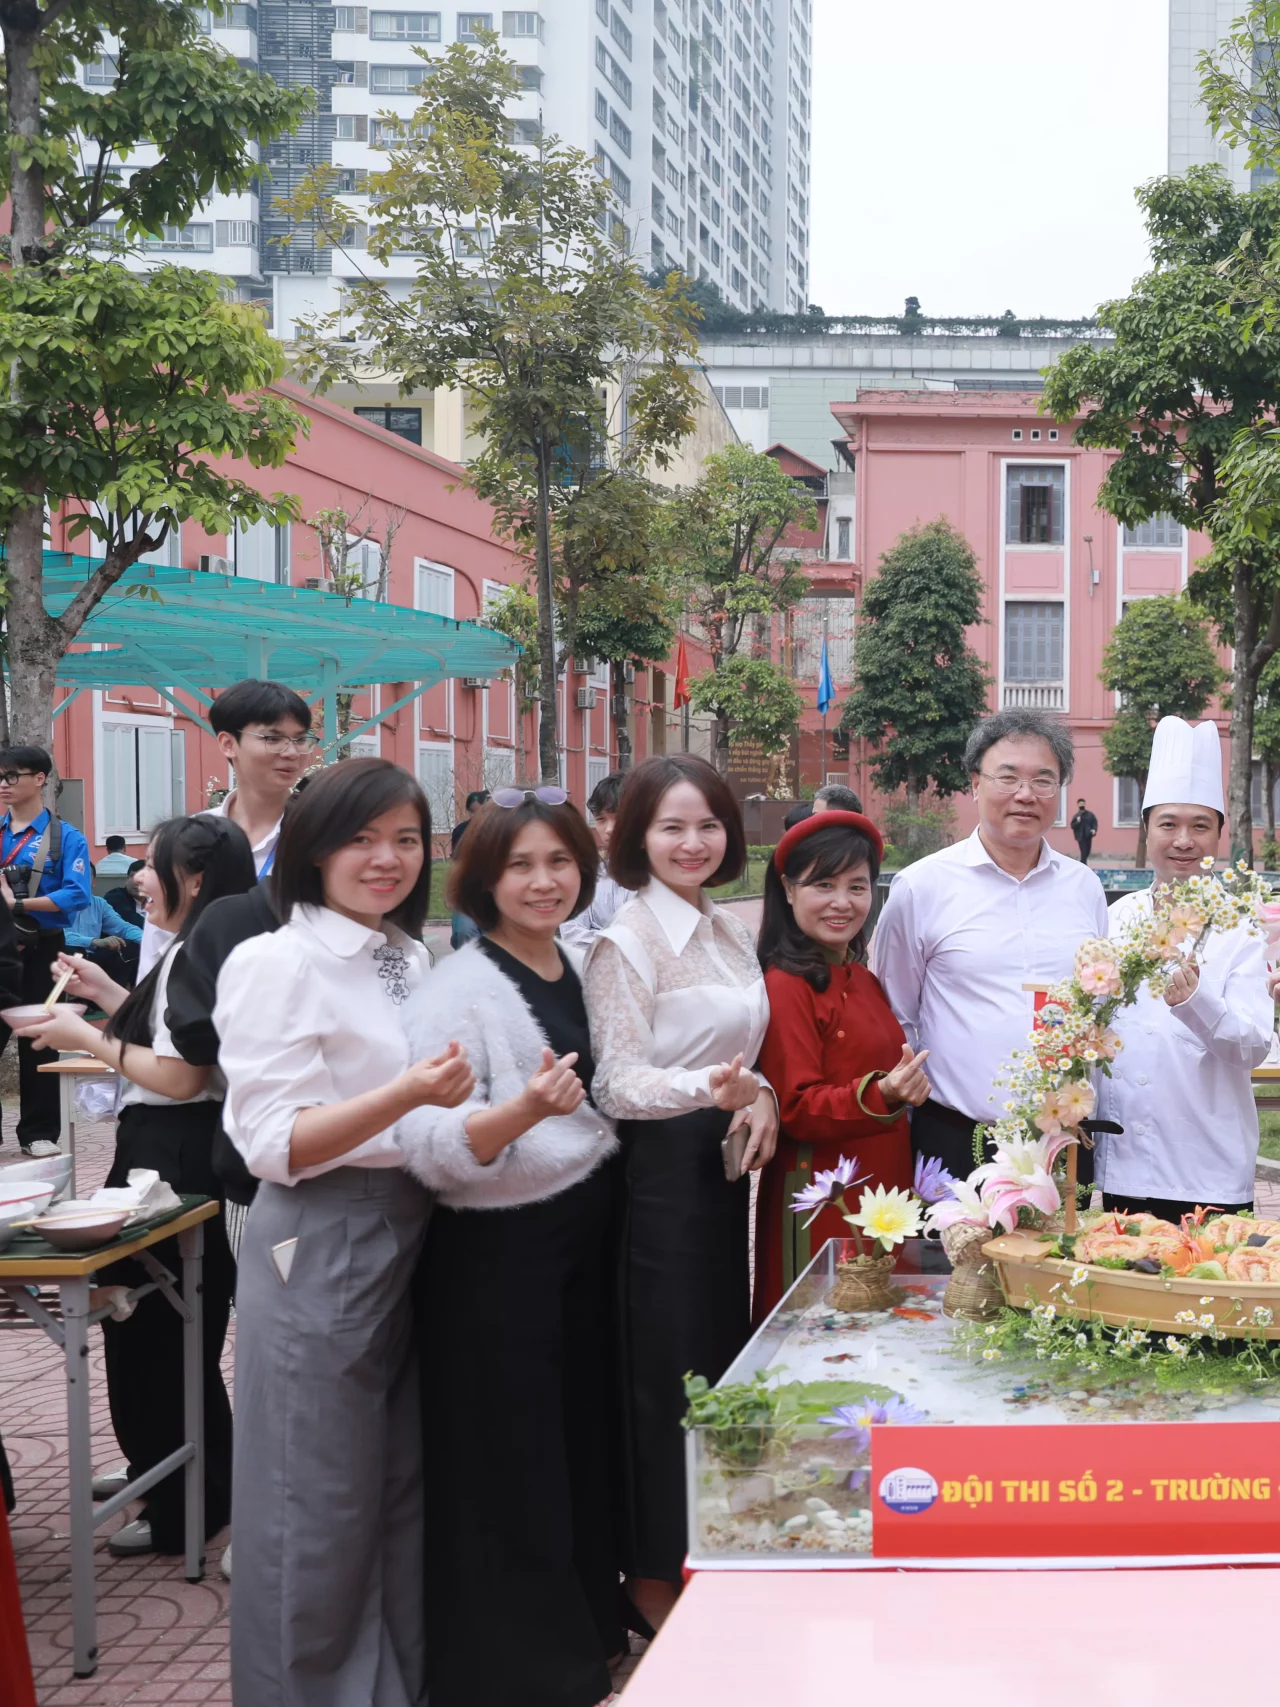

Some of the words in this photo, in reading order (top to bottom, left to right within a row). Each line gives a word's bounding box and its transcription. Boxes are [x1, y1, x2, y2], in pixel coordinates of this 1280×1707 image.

[942, 1474, 993, 1510] ĐỘI
[1001, 1478, 1049, 1504] THI
[1059, 1469, 1097, 1503] SỐ
[1106, 1478, 1123, 1503] 2
[1151, 1472, 1270, 1502] TRƯỜNG
